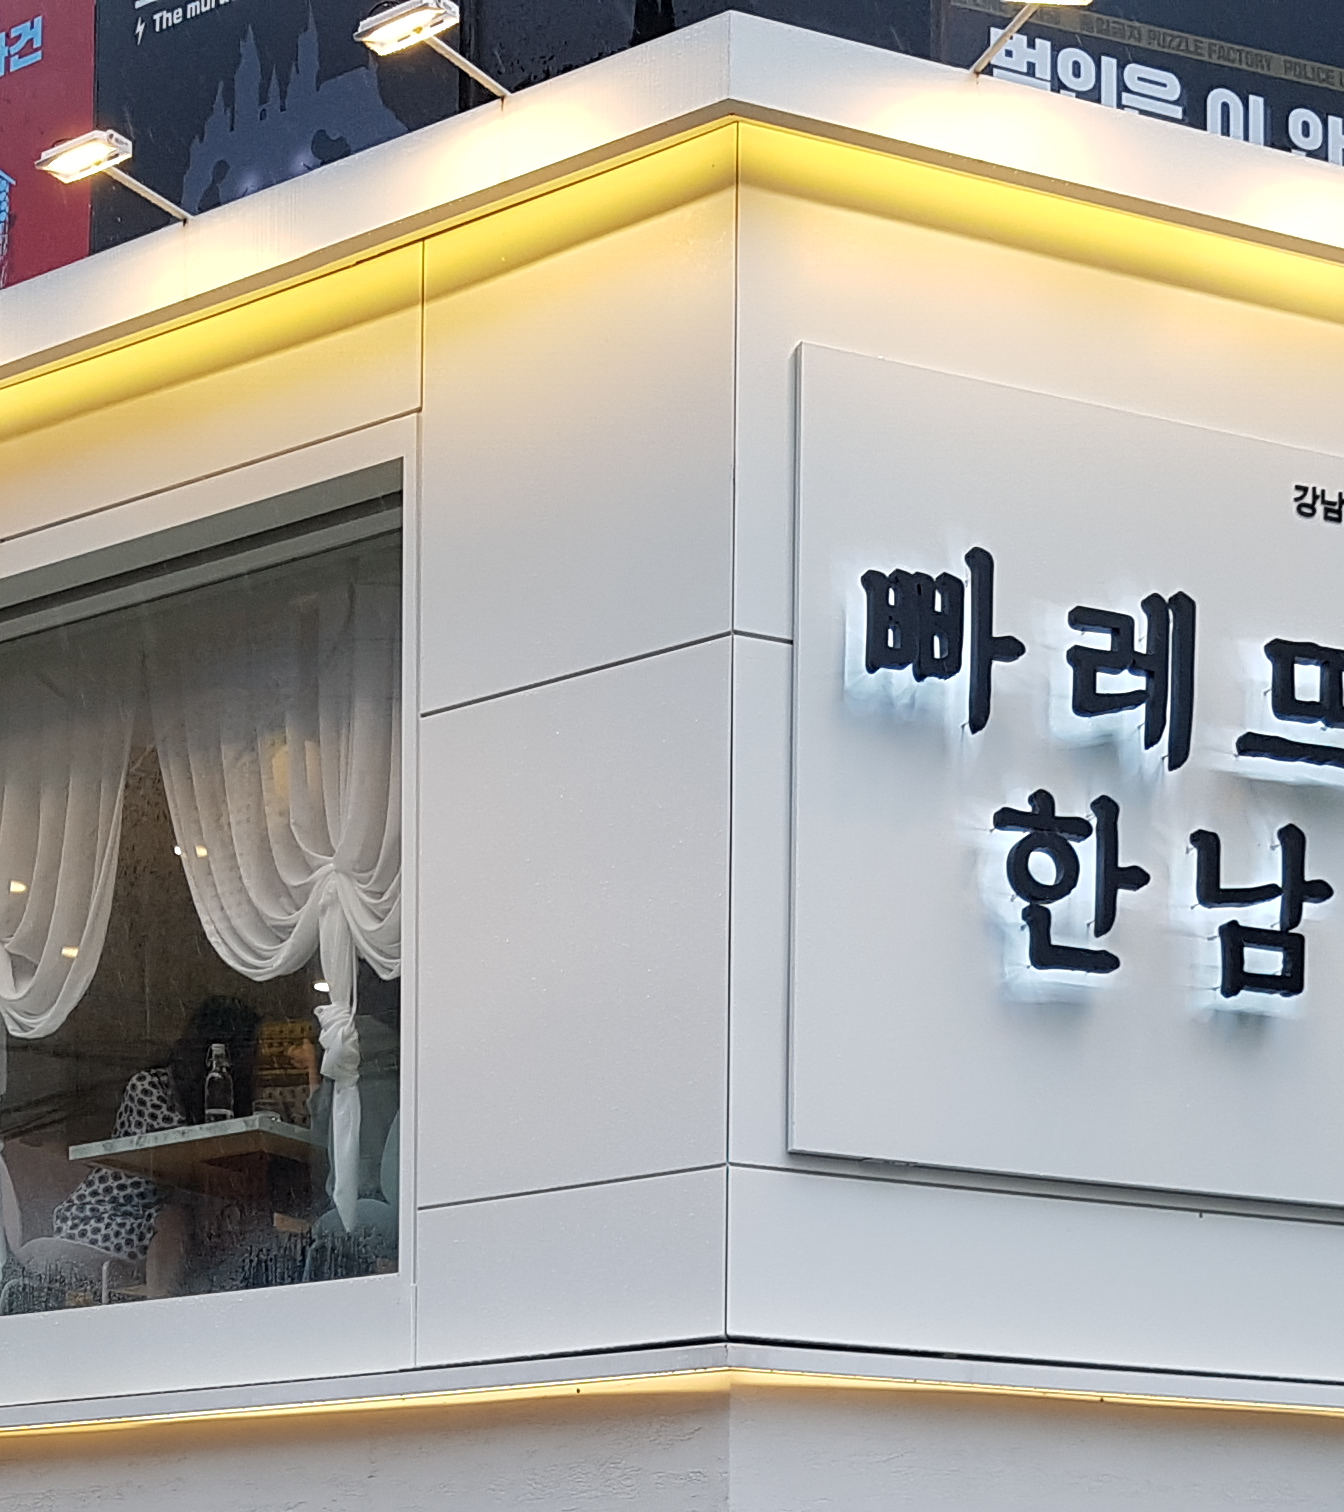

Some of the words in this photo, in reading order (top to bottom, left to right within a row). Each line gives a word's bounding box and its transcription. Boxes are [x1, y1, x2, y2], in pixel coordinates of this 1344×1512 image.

[153, 8, 183, 32] The
[1149, 25, 1206, 54] PUZZLE
[1207, 43, 1272, 71] FACTORY
[1283, 59, 1335, 84] POLICE
[992, 788, 1335, 999] 한남
